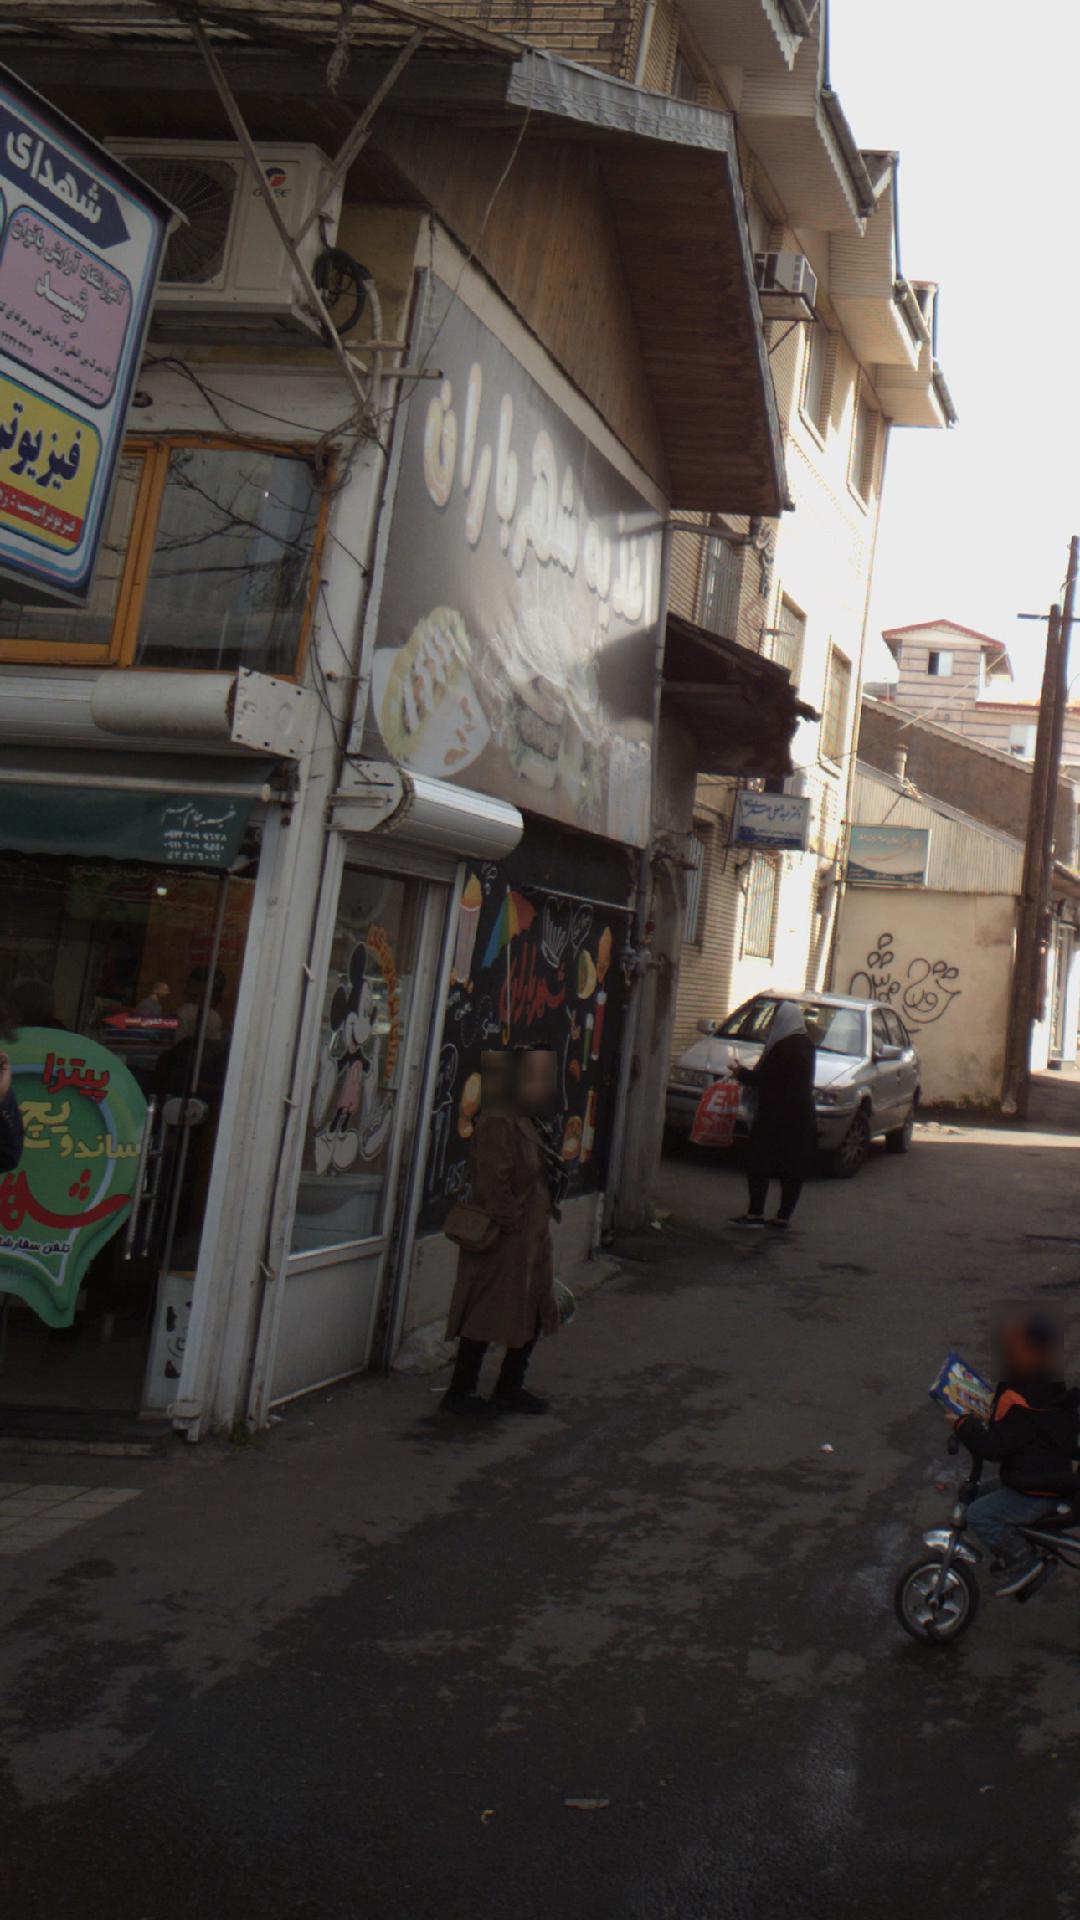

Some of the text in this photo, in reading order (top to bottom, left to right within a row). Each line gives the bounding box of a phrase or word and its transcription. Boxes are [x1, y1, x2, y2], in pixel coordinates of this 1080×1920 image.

[6, 129, 102, 225] شهدای
[423, 361, 519, 555] باران
[511, 428, 580, 578] شهر
[41, 1052, 111, 1104] پیتزا
[0, 1168, 132, 1232] شه
